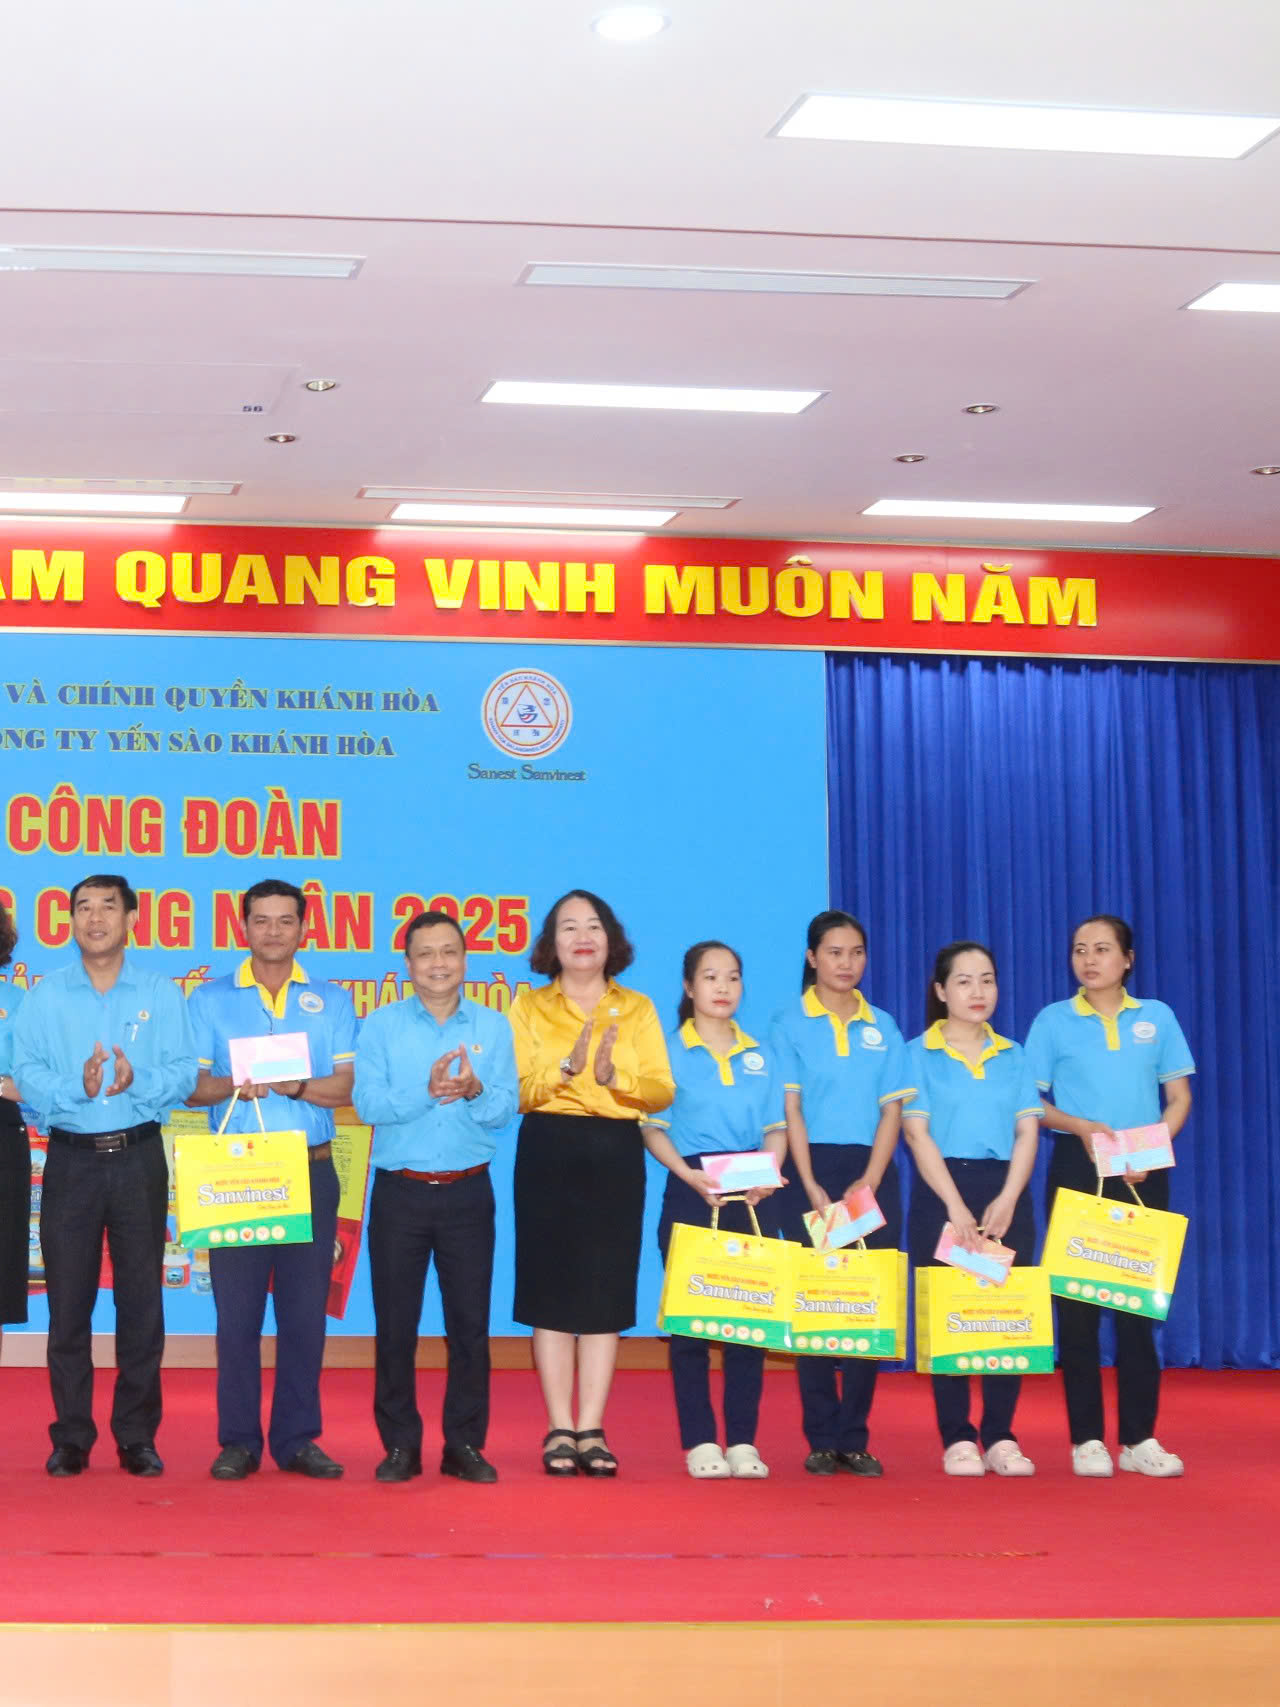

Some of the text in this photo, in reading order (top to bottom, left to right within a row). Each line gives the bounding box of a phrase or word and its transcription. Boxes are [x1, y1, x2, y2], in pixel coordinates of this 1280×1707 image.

[115, 552, 396, 612] QUANG
[424, 558, 615, 614] VINH
[644, 555, 885, 621] MUÔN
[911, 562, 1097, 627] NĂM
[5, 678, 49, 705] VÀ
[57, 680, 157, 706] CHÍNH
[164, 678, 268, 713] QUYỀN
[276, 685, 376, 712] KHÁNH
[381, 687, 441, 713] HÒA
[55, 729, 98, 750] TY
[108, 722, 161, 753] YẾN
[168, 727, 223, 753] SÀO
[230, 728, 330, 755] KHÁNH
[336, 731, 397, 757] HÒA
[468, 763, 586, 781] Sanest Sanvinest
[7, 782, 166, 858] CÔNG
[183, 786, 342, 860] ĐOÀN
[212, 880, 375, 952] NÂN
[198, 1184, 289, 1206] Sanvinest
[1066, 1236, 1156, 1275] Sanvinest
[688, 1274, 776, 1306] Sanvinest
[795, 1291, 877, 1315] Sanvinest
[947, 1312, 1032, 1333] Sanvinest
